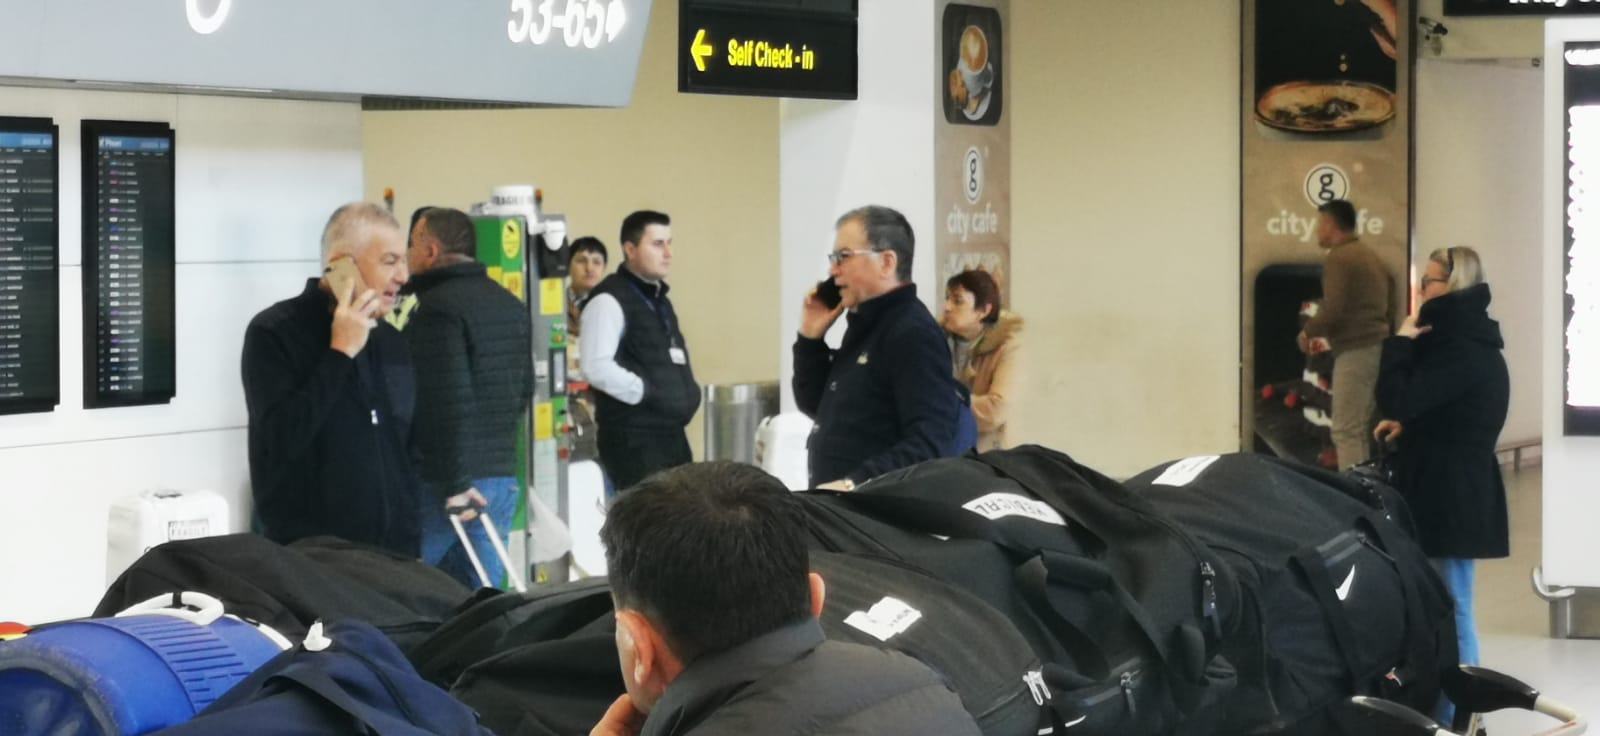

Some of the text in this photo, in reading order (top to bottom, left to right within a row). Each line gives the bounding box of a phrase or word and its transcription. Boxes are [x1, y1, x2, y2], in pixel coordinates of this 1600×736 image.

[508, 0, 605, 48] 53-65
[728, 38, 753, 66] Self
[755, 41, 792, 68] Check
[802, 44, 814, 70] in
[1318, 173, 1335, 201] g
[947, 202, 997, 242] city cafe
[1266, 208, 1383, 242] city fe
